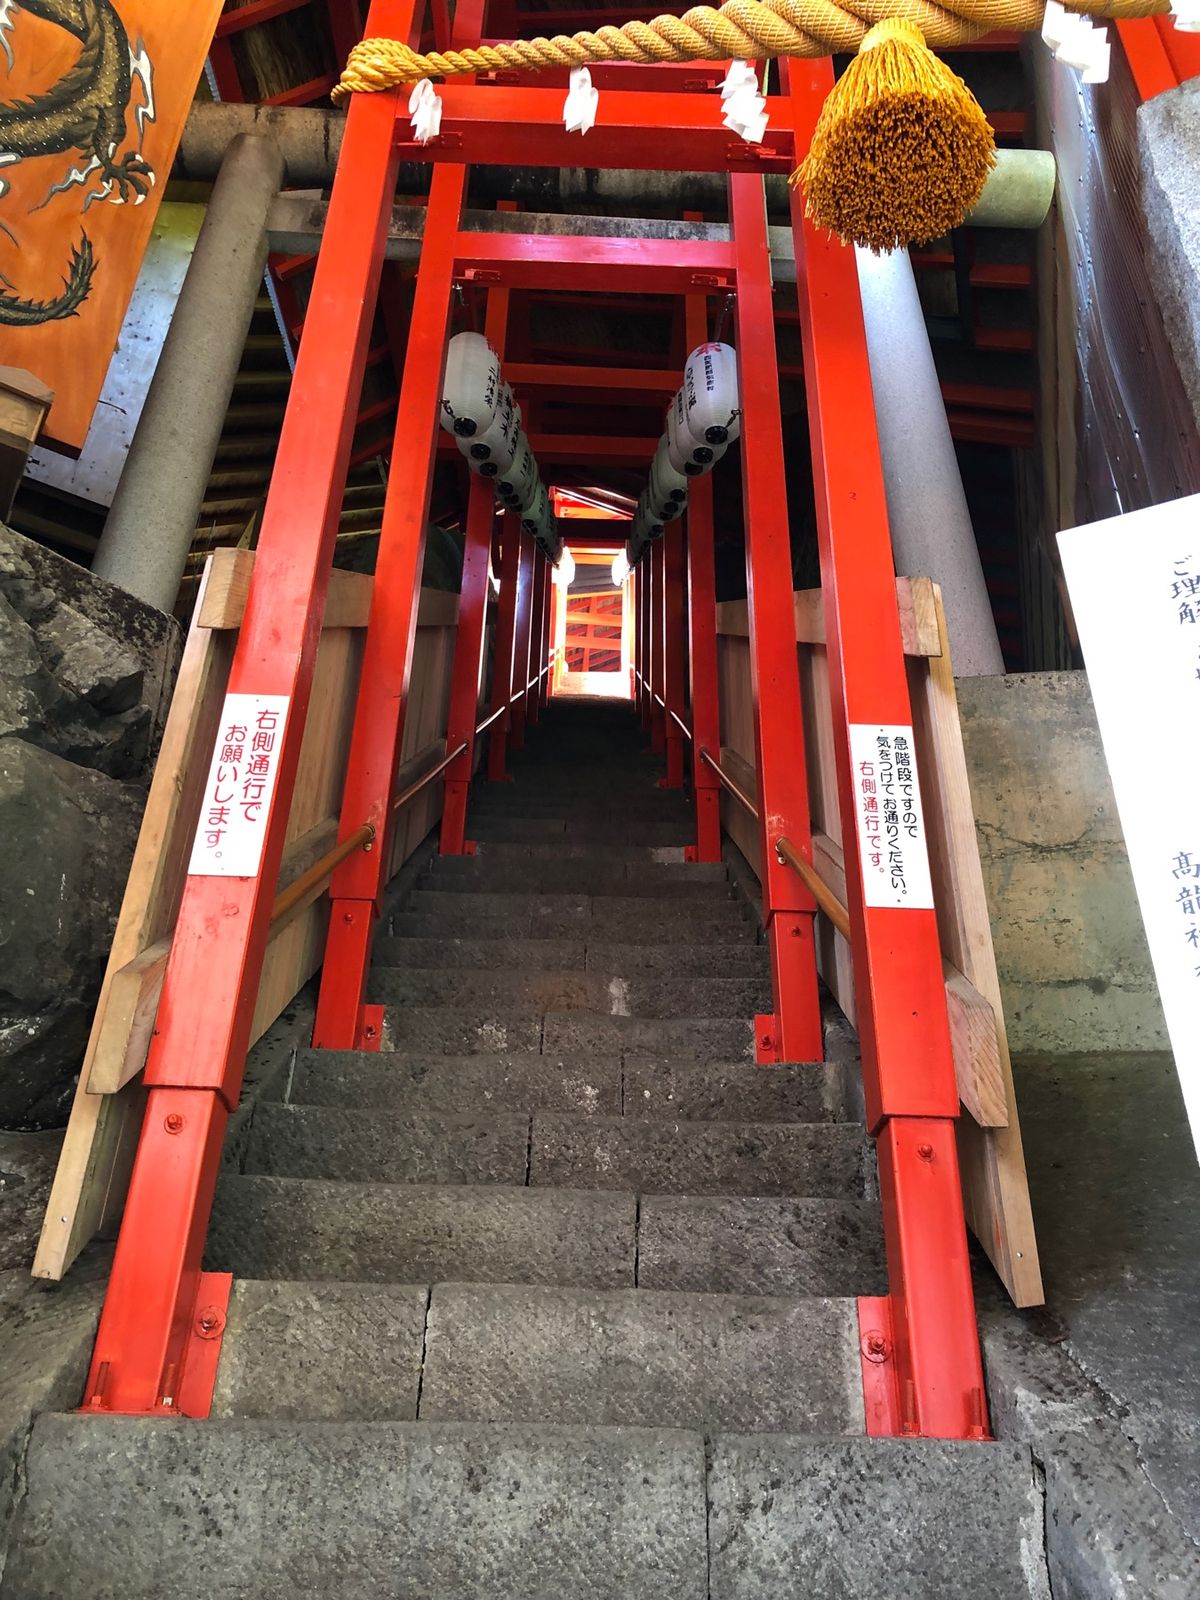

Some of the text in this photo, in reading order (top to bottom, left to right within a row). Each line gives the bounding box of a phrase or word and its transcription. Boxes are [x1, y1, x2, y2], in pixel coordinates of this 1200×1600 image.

[204, 724, 248, 859] お願いします。
[239, 709, 280, 823] 右側通行で
[859, 760, 885, 874] 右側通行です。
[876, 735, 907, 895] 気をつけてお通りください。
[893, 735, 918, 838] 急階段ですので
